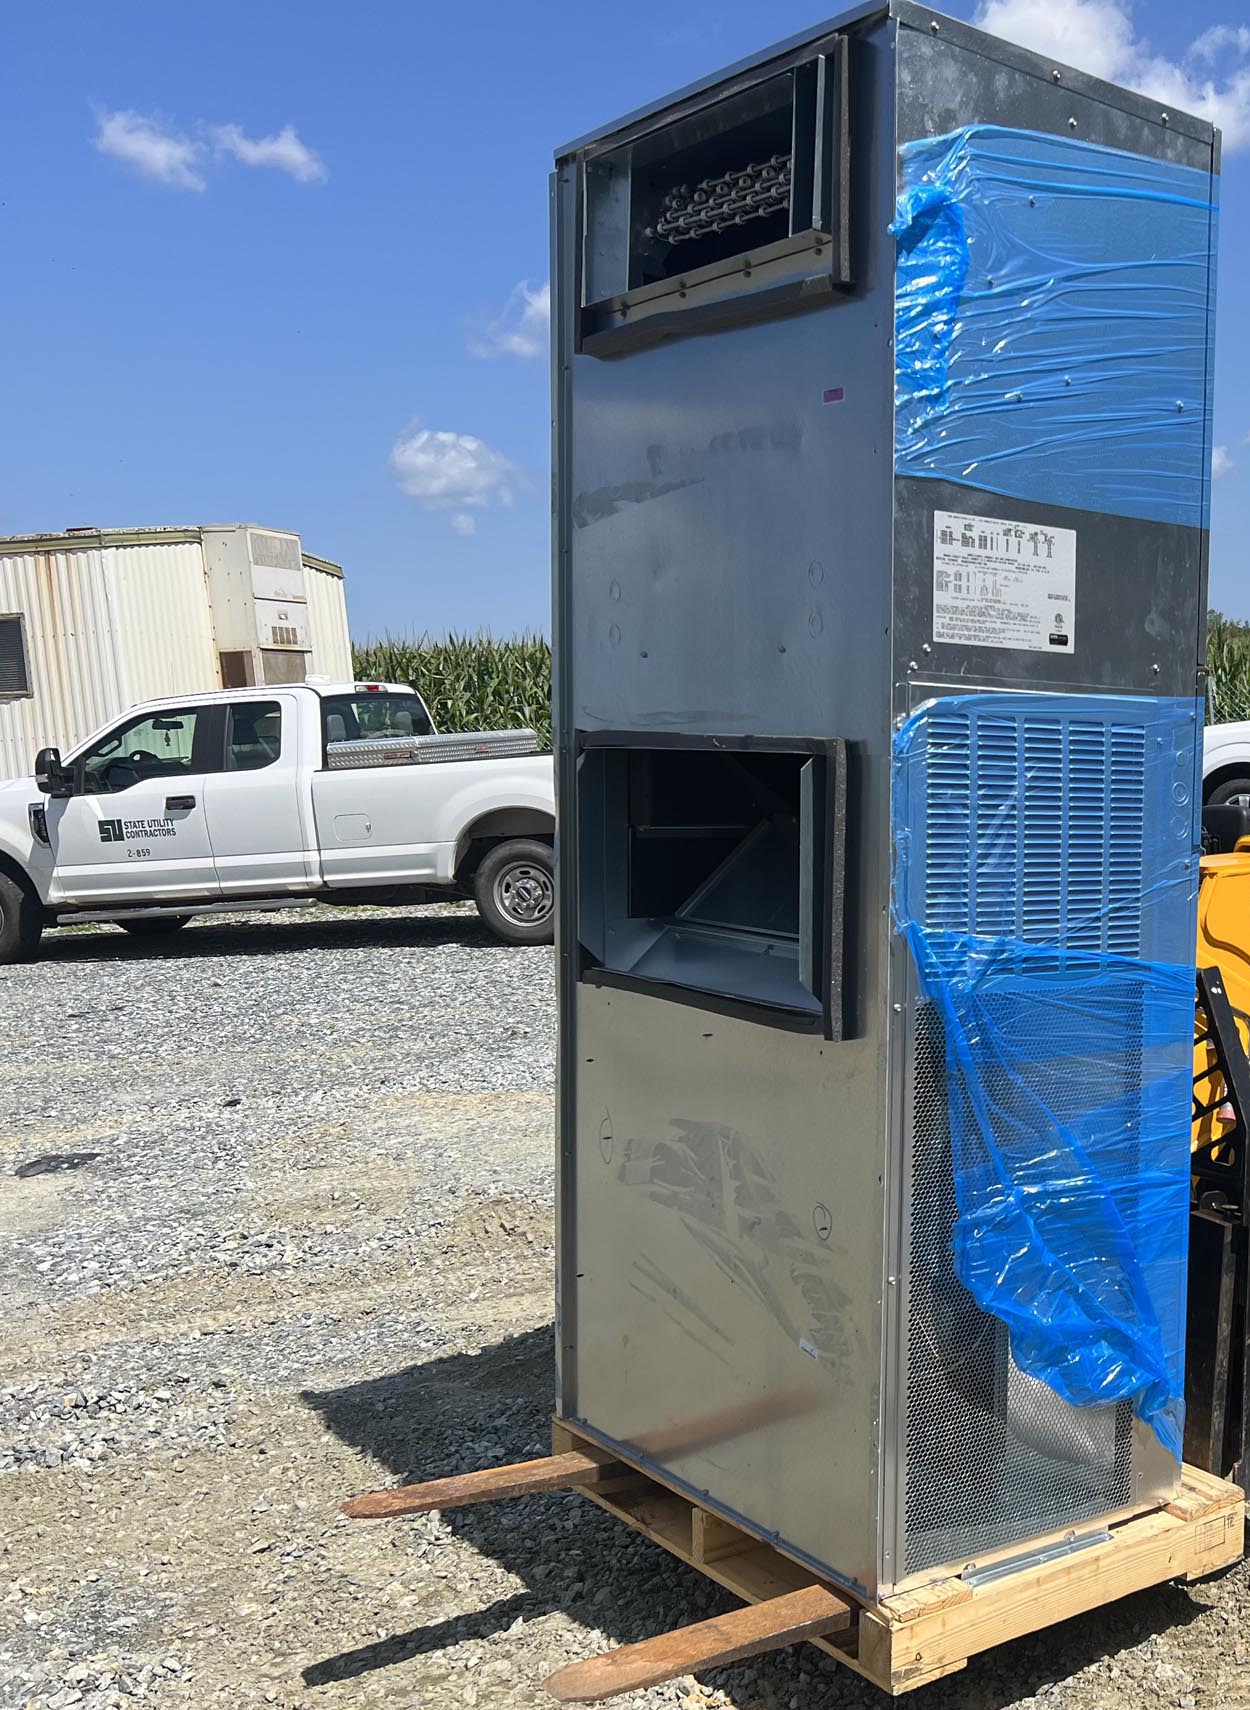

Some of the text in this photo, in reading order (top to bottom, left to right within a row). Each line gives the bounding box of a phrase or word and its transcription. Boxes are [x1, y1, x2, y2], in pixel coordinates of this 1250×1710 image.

[124, 820, 146, 830] STATE
[147, 818, 175, 828] UTILITY
[125, 828, 177, 839] CONTRACTORS
[127, 848, 151, 858] 2-859
